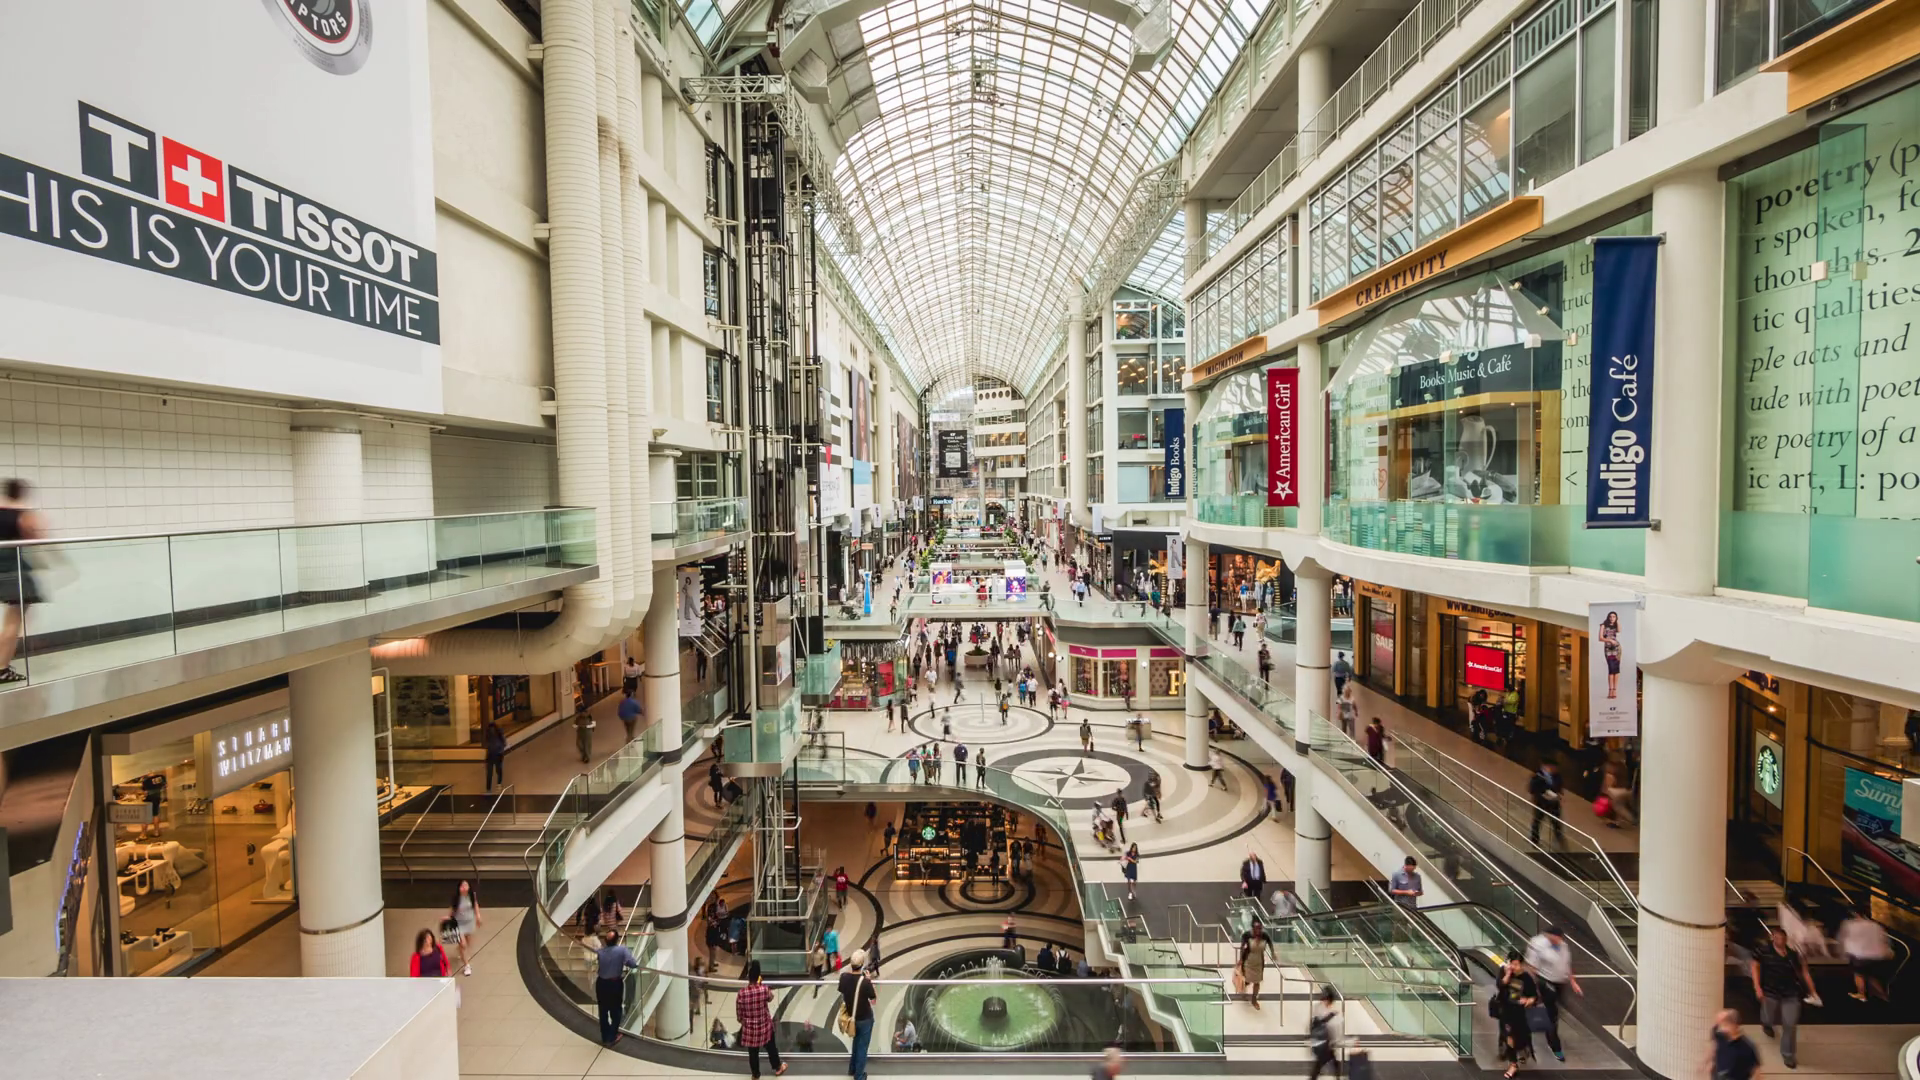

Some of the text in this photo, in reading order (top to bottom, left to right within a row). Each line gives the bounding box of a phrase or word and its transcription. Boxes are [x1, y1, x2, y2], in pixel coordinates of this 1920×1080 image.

[290, 0, 347, 36] PTORS
[88, 113, 419, 283] T TISSOT
[1773, 204, 1885, 257] spoken,
[131, 205, 180, 269] IS
[194, 226, 332, 312] YOUR
[339, 274, 422, 336] TIME
[1356, 249, 1448, 307] CREATIVITY
[1752, 308, 1785, 333] tic
[1204, 350, 1244, 377] IMAGINATION
[1420, 371, 1446, 389] Books
[1447, 365, 1476, 384] Music
[1477, 362, 1488, 378] &
[1487, 354, 1512, 375] Café
[1749, 323, 1911, 382] ple acts and
[1750, 385, 1789, 411] ude
[1799, 378, 1850, 407] with
[1597, 354, 1645, 515] Indigo Café
[1748, 416, 1917, 459] re poetry of a
[1167, 436, 1182, 496] Indigo Books
[1748, 464, 1920, 501] ic art, L: po
[1375, 633, 1393, 651] SALE
[218, 719, 290, 757] STUART
[219, 737, 292, 777] WEITZMAN
